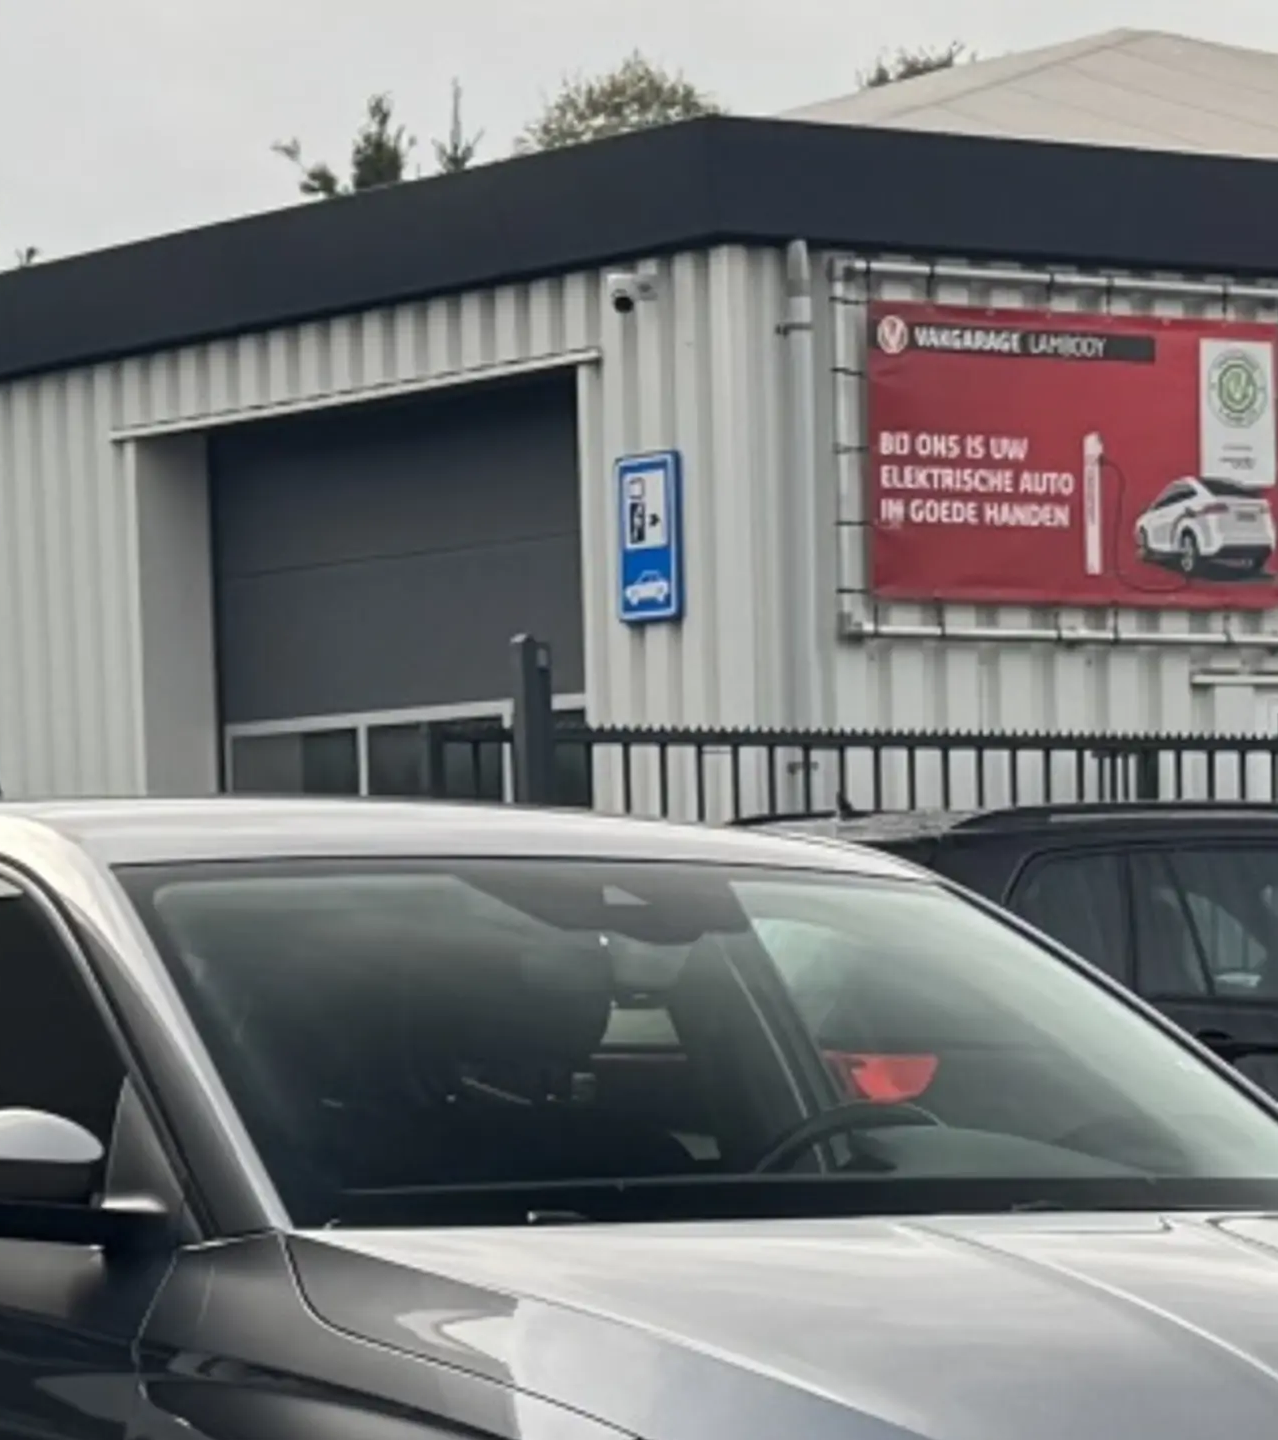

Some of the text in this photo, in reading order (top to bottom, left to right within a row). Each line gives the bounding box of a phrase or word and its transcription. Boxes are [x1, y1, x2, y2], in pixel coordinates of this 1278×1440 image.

[914, 326, 1107, 358] VAKGARAGE LAMBOOY
[915, 433, 961, 459] ONS
[966, 435, 985, 460] IS
[989, 437, 1029, 461] UW
[880, 465, 1015, 494] ELEKTRISCHE
[1019, 471, 1076, 496] AUTO
[880, 498, 1071, 528] IN GOEDE HANDEN
